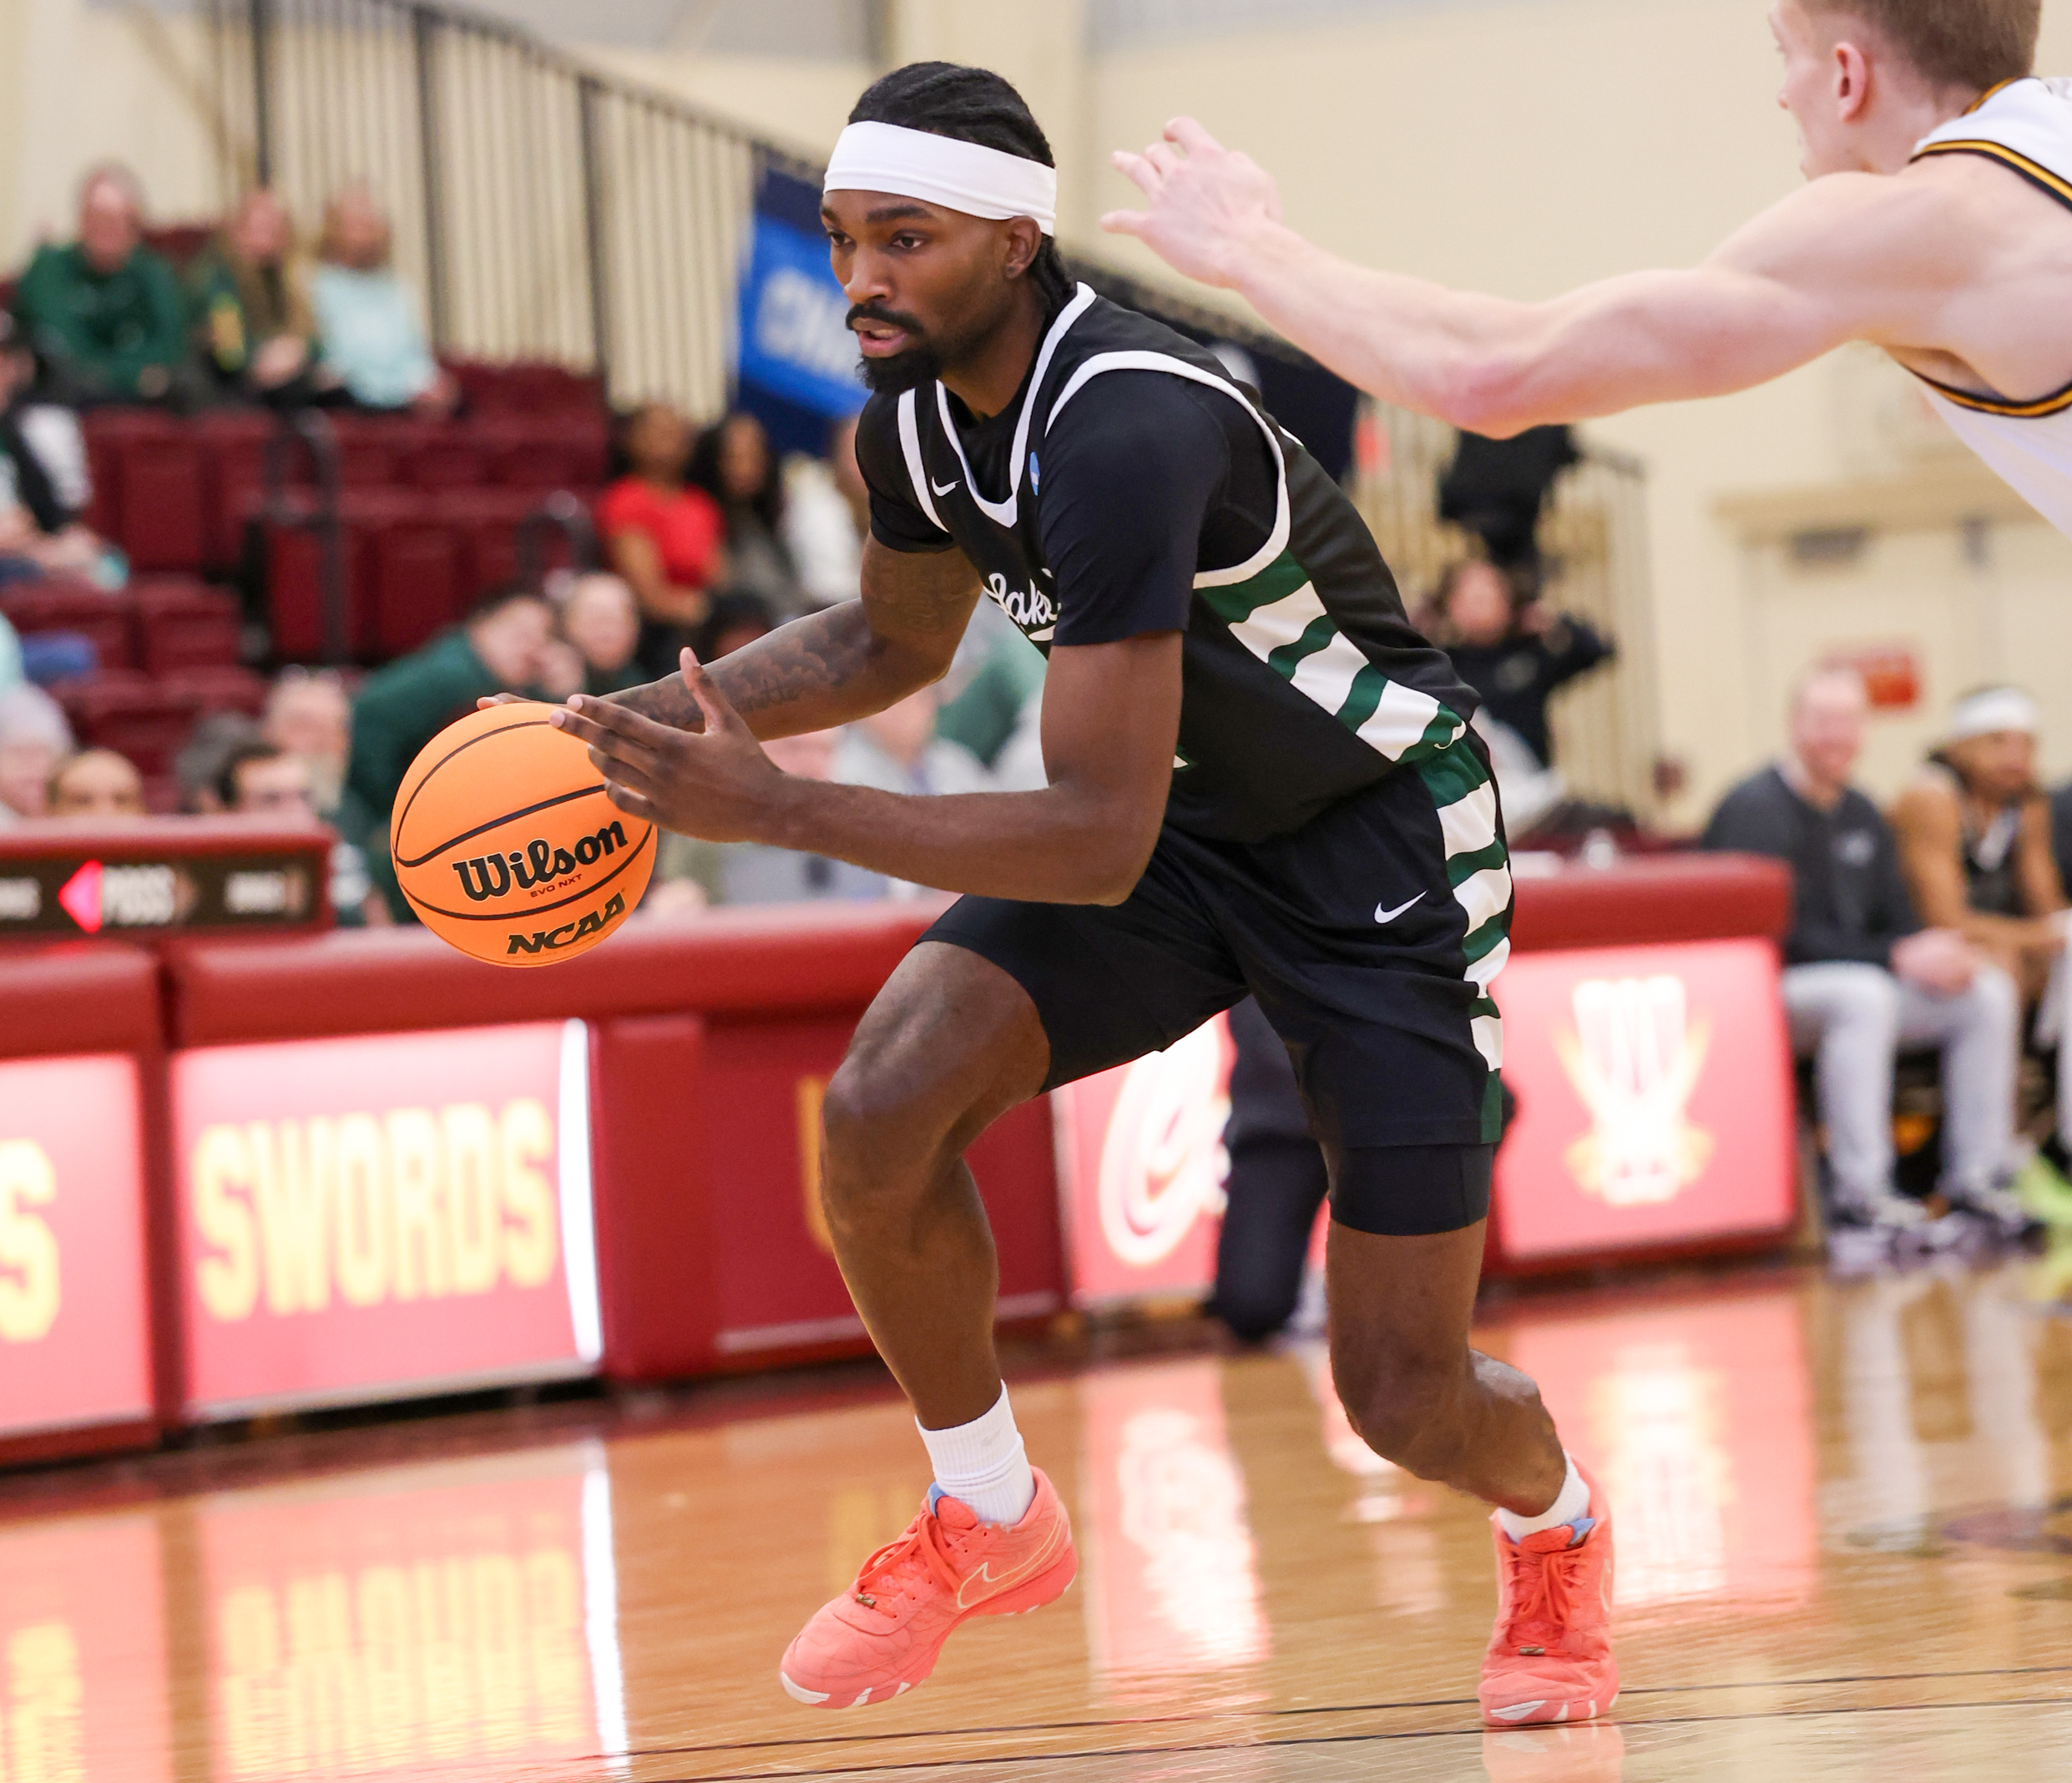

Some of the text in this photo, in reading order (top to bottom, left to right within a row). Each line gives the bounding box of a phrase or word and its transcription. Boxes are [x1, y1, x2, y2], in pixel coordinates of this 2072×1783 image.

[452, 821, 628, 902] Wilson
[530, 874, 583, 897] EVO NXT
[507, 892, 625, 954] NCAA
[193, 1098, 558, 1322] SWORDS
